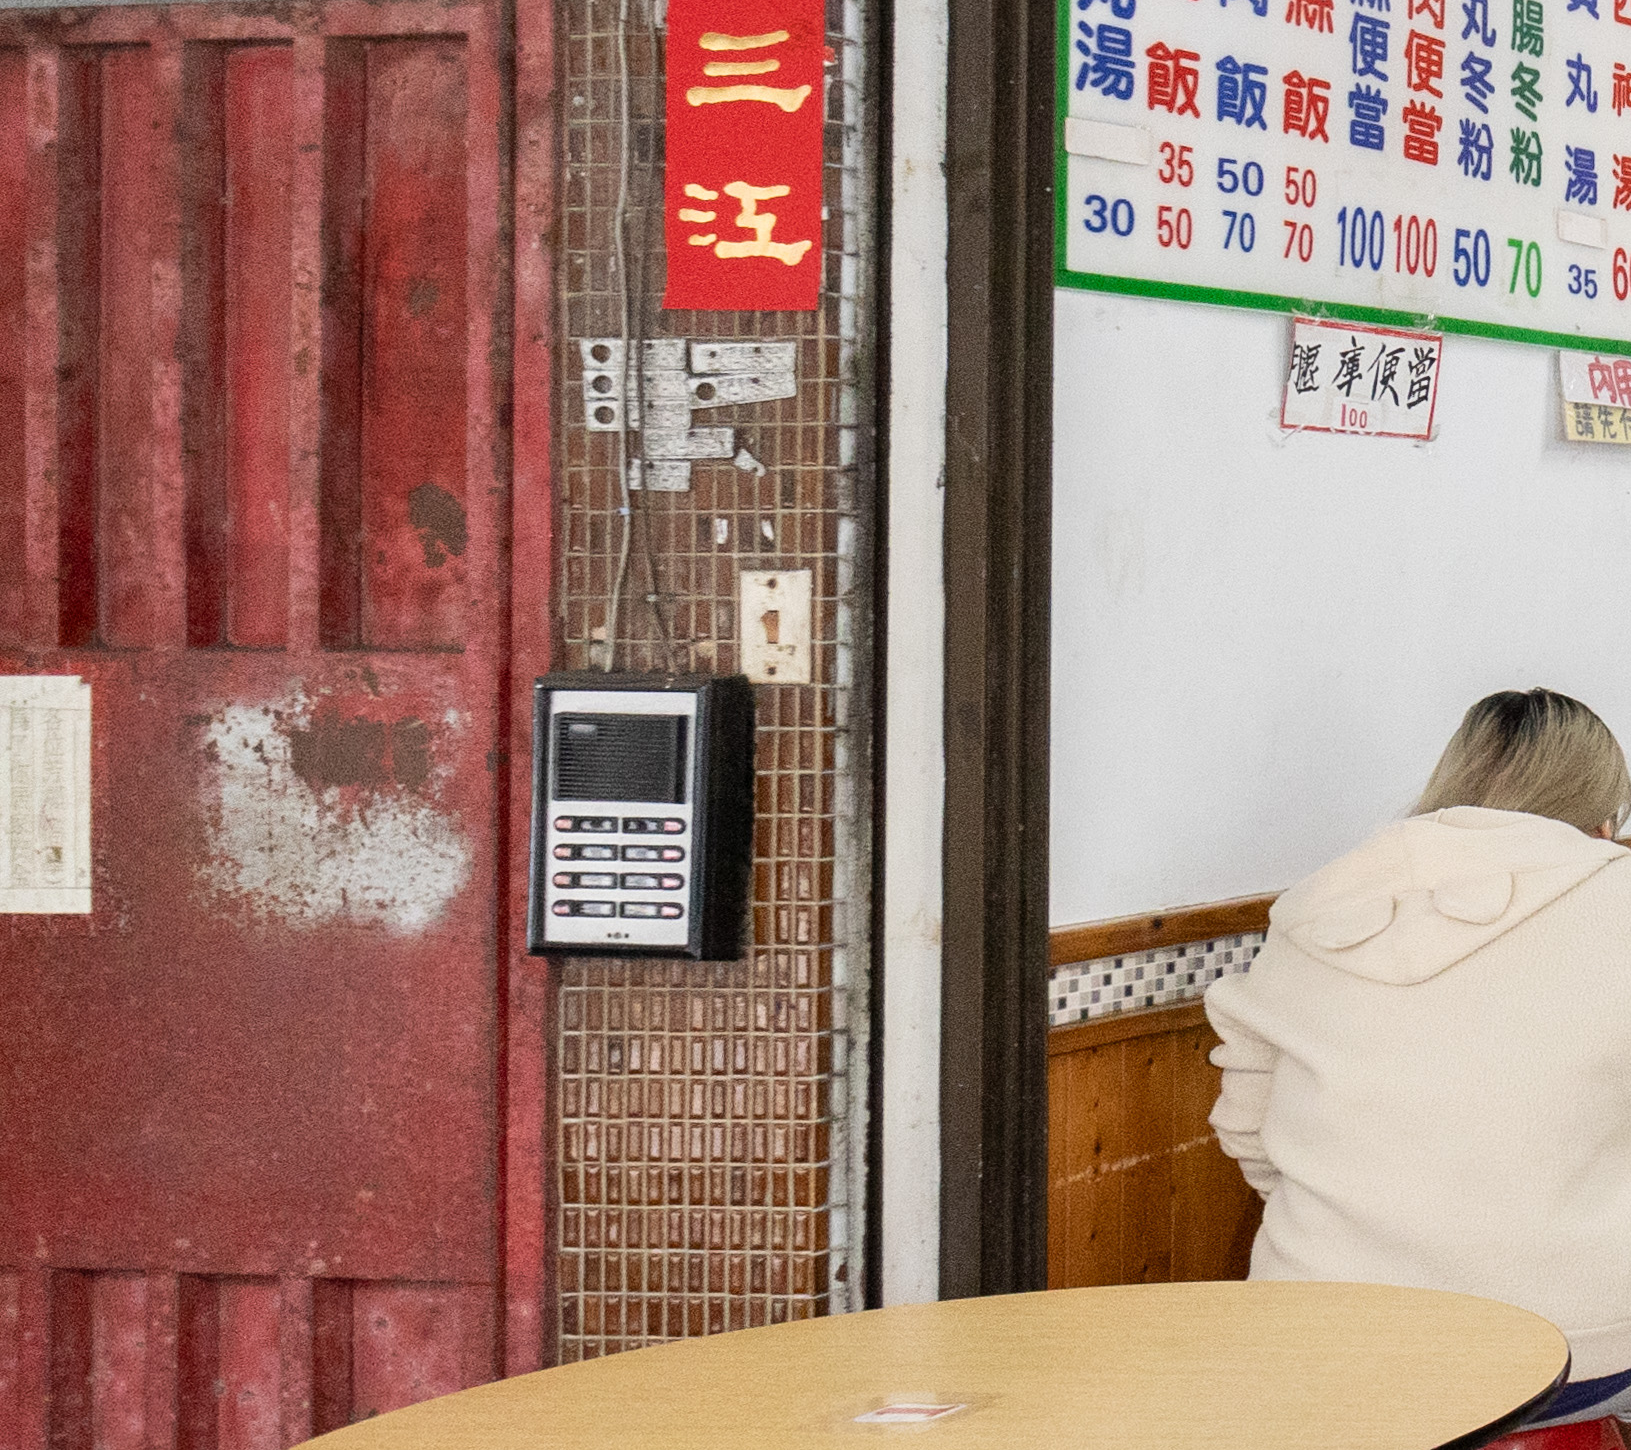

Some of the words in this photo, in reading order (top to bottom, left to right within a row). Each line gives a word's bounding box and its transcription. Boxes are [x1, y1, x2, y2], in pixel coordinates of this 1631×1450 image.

[1158, 142, 1194, 188] 35
[1216, 158, 1265, 198] 50
[1285, 166, 1317, 209] 50
[1084, 195, 1135, 237] 30
[1157, 205, 1193, 252] 50
[1222, 210, 1256, 254] 70
[1283, 220, 1314, 264] 70
[1338, 205, 1385, 272] 100
[1395, 213, 1439, 279] 100
[1453, 228, 1491, 288] 50
[1507, 238, 1543, 299] 70
[1567, 262, 1598, 300] 35
[1341, 403, 1368, 429] 100
